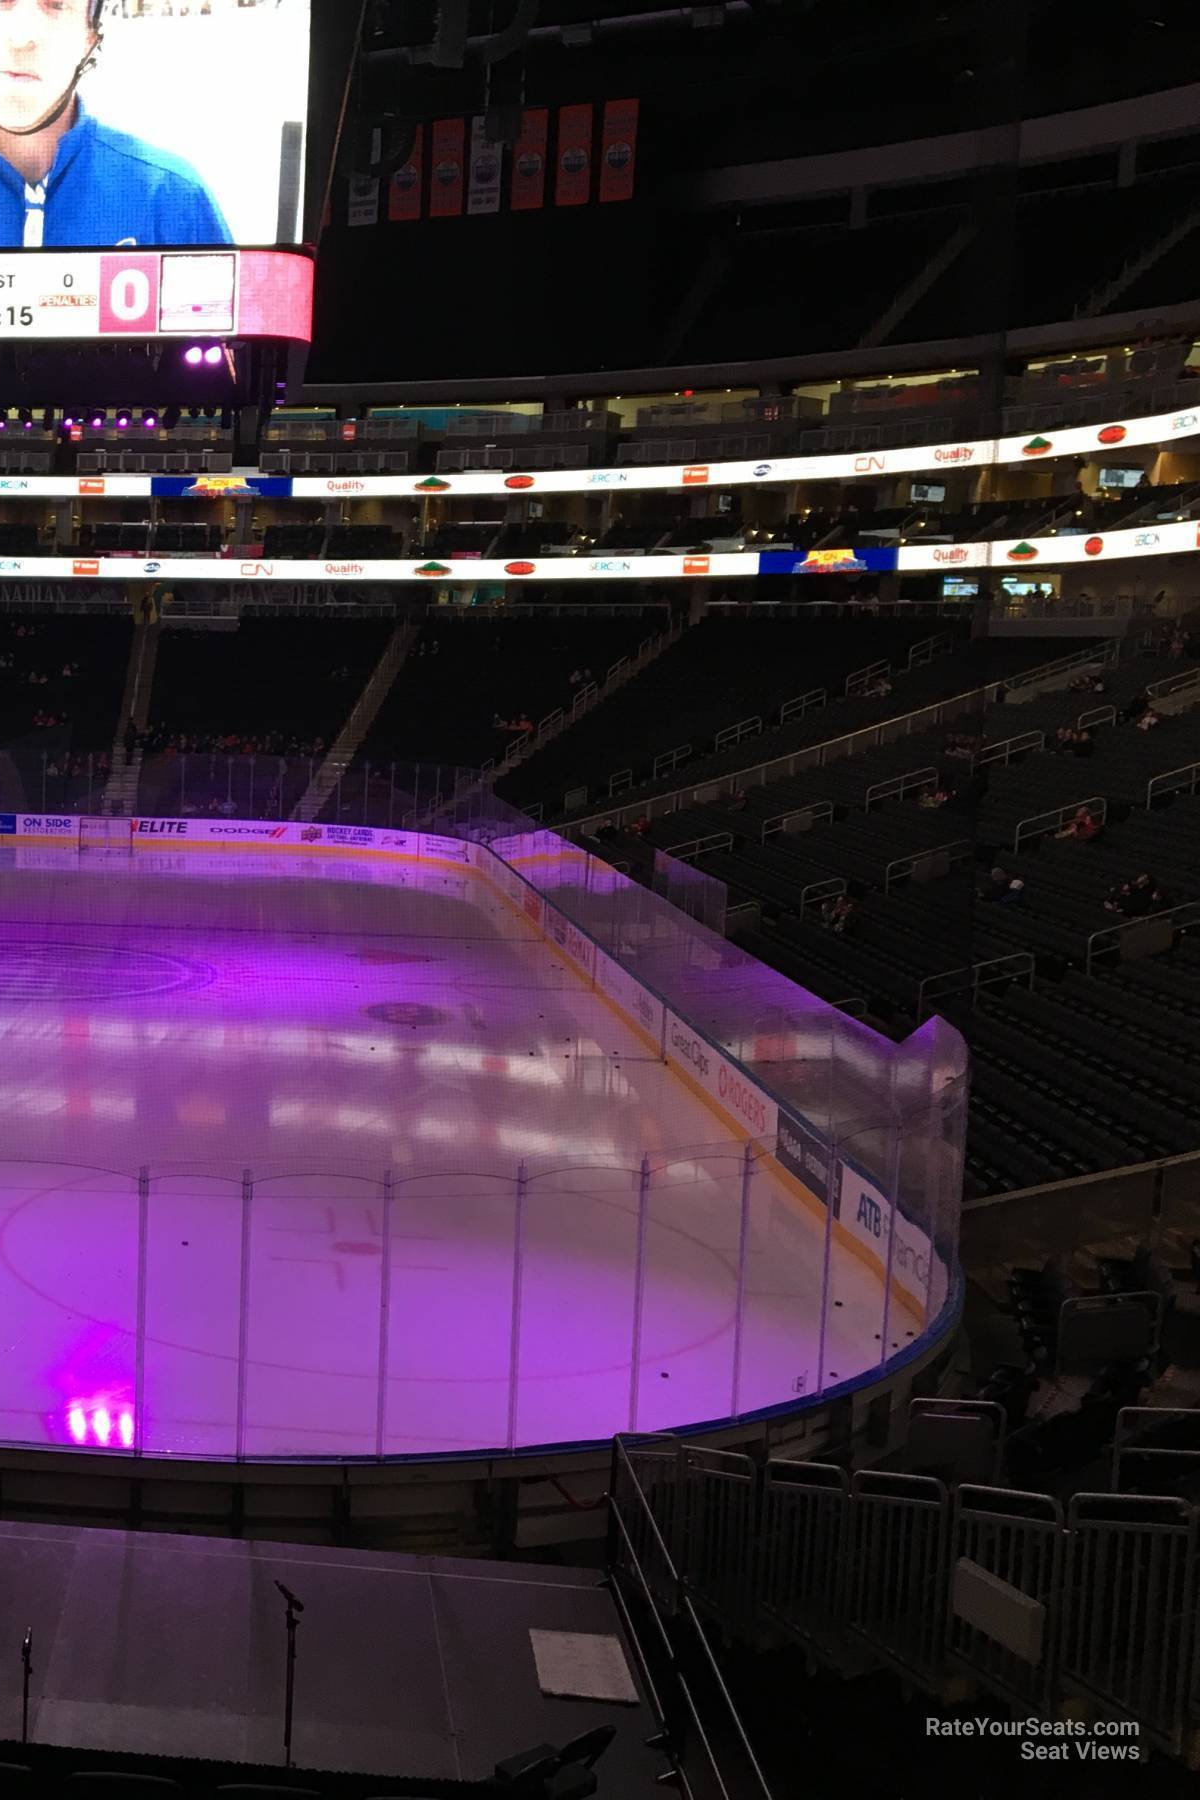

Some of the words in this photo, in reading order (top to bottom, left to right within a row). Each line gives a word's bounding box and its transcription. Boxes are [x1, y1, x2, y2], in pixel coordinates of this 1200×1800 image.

[63, 274, 74, 288] 0
[110, 269, 150, 320] 0
[934, 447, 973, 463] Quality
[327, 480, 365, 492] Quality
[933, 547, 969, 562] Quality
[325, 563, 364, 576] Quality
[23, 818, 42, 828] ON
[138, 820, 188, 834] ELITE
[210, 827, 274, 835] DODGE
[856, 1193, 881, 1239] ATB
